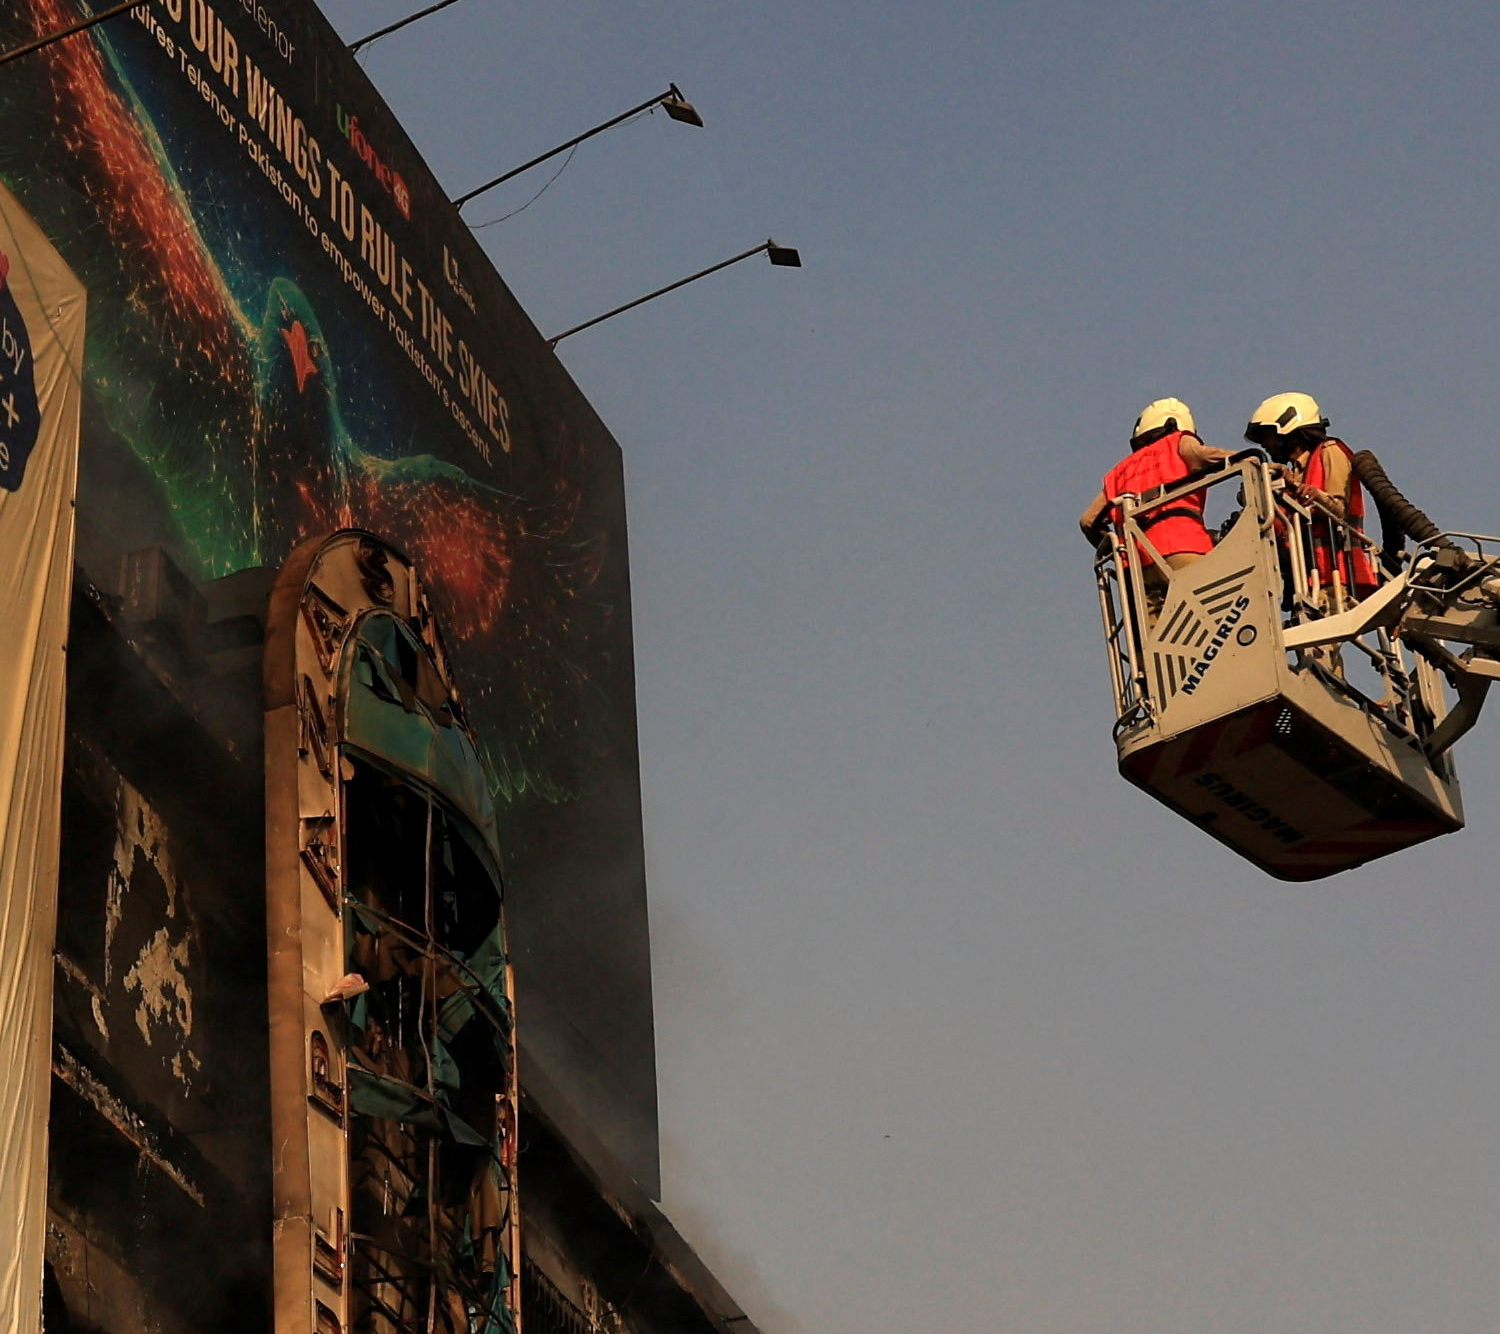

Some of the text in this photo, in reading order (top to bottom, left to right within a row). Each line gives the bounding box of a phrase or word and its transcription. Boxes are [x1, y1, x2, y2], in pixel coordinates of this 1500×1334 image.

[178, 47, 236, 133] Telenor
[238, 121, 303, 218] Pakistan
[304, 209, 320, 238] to
[320, 231, 386, 321] empower
[388, 310, 450, 408] Pakistan's
[245, 54, 322, 200] WINGS
[325, 158, 355, 243] TO
[360, 203, 414, 322] RULE
[416, 278, 455, 378] THE
[457, 338, 511, 454] SKIES
[1, 317, 25, 376] by
[1181, 595, 1250, 695] MAGIRUS
